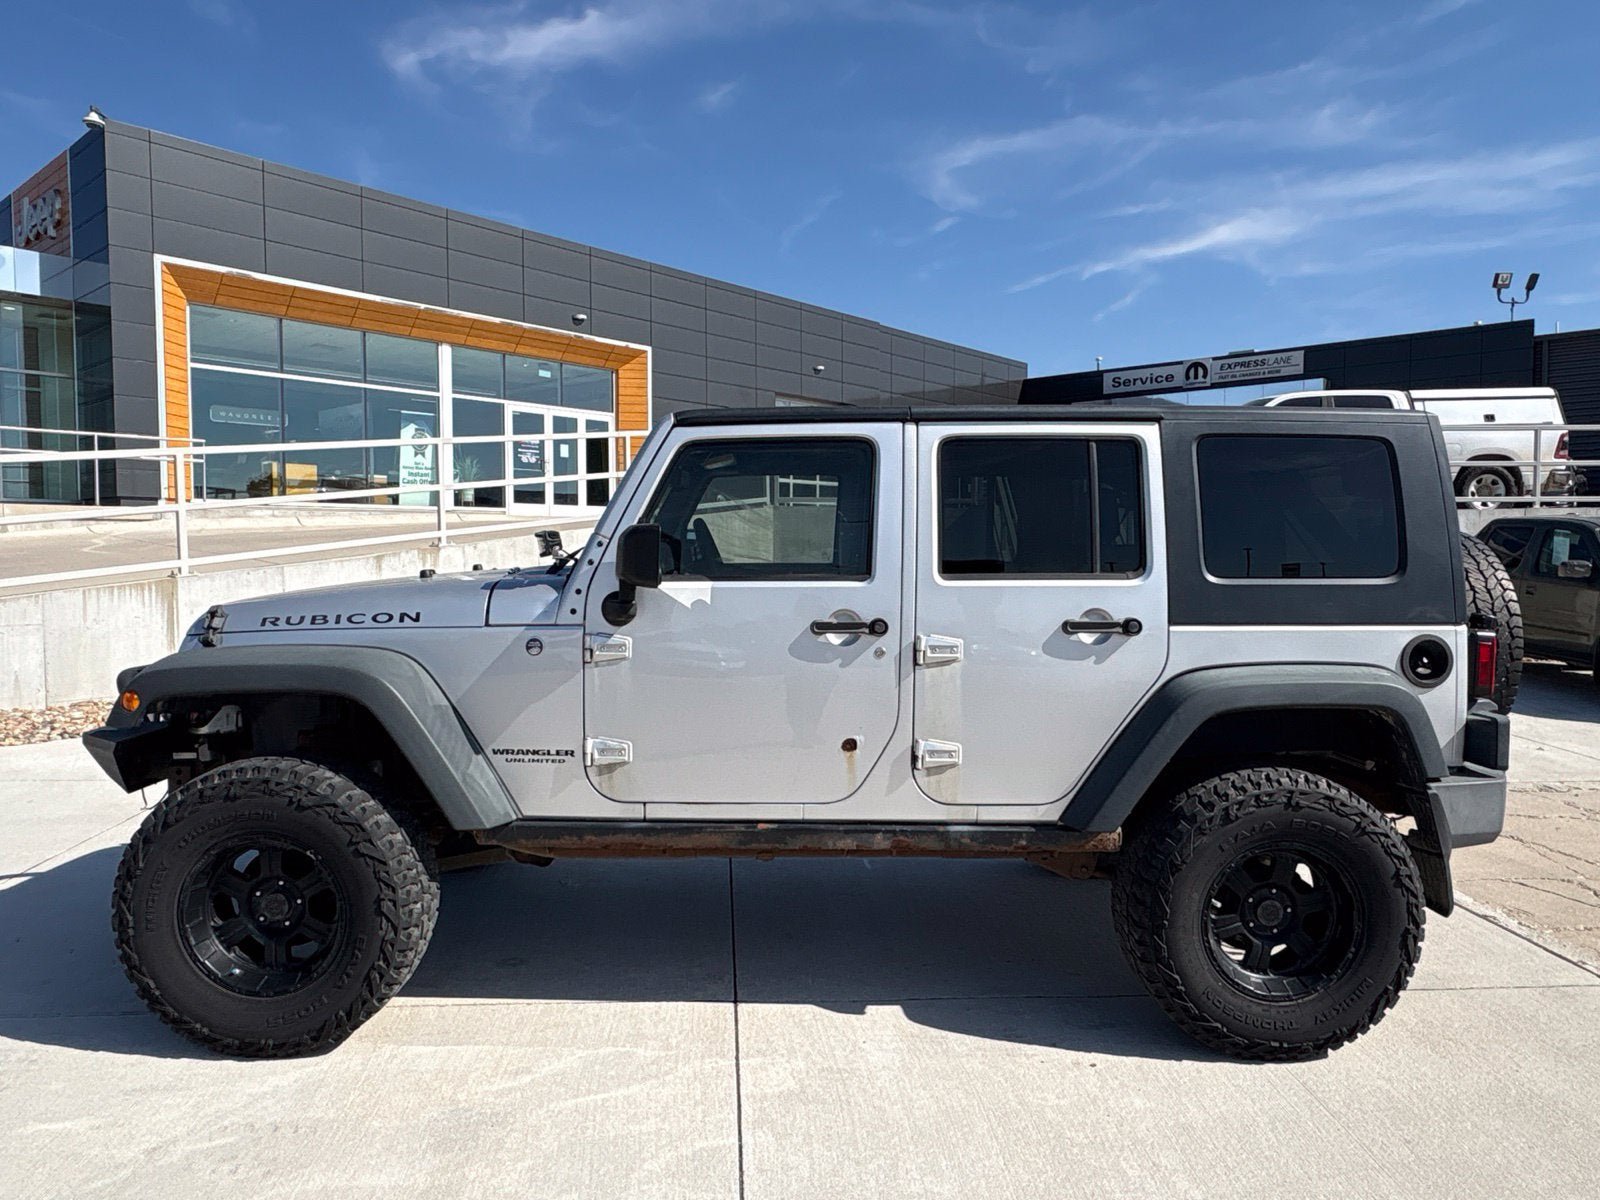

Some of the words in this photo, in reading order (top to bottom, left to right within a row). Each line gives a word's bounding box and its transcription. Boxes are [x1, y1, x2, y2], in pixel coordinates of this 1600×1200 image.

[15, 190, 62, 247] Jeep
[1111, 372, 1175, 388] Service
[260, 612, 421, 627] RUBICON
[492, 748, 575, 757] WRANGLER
